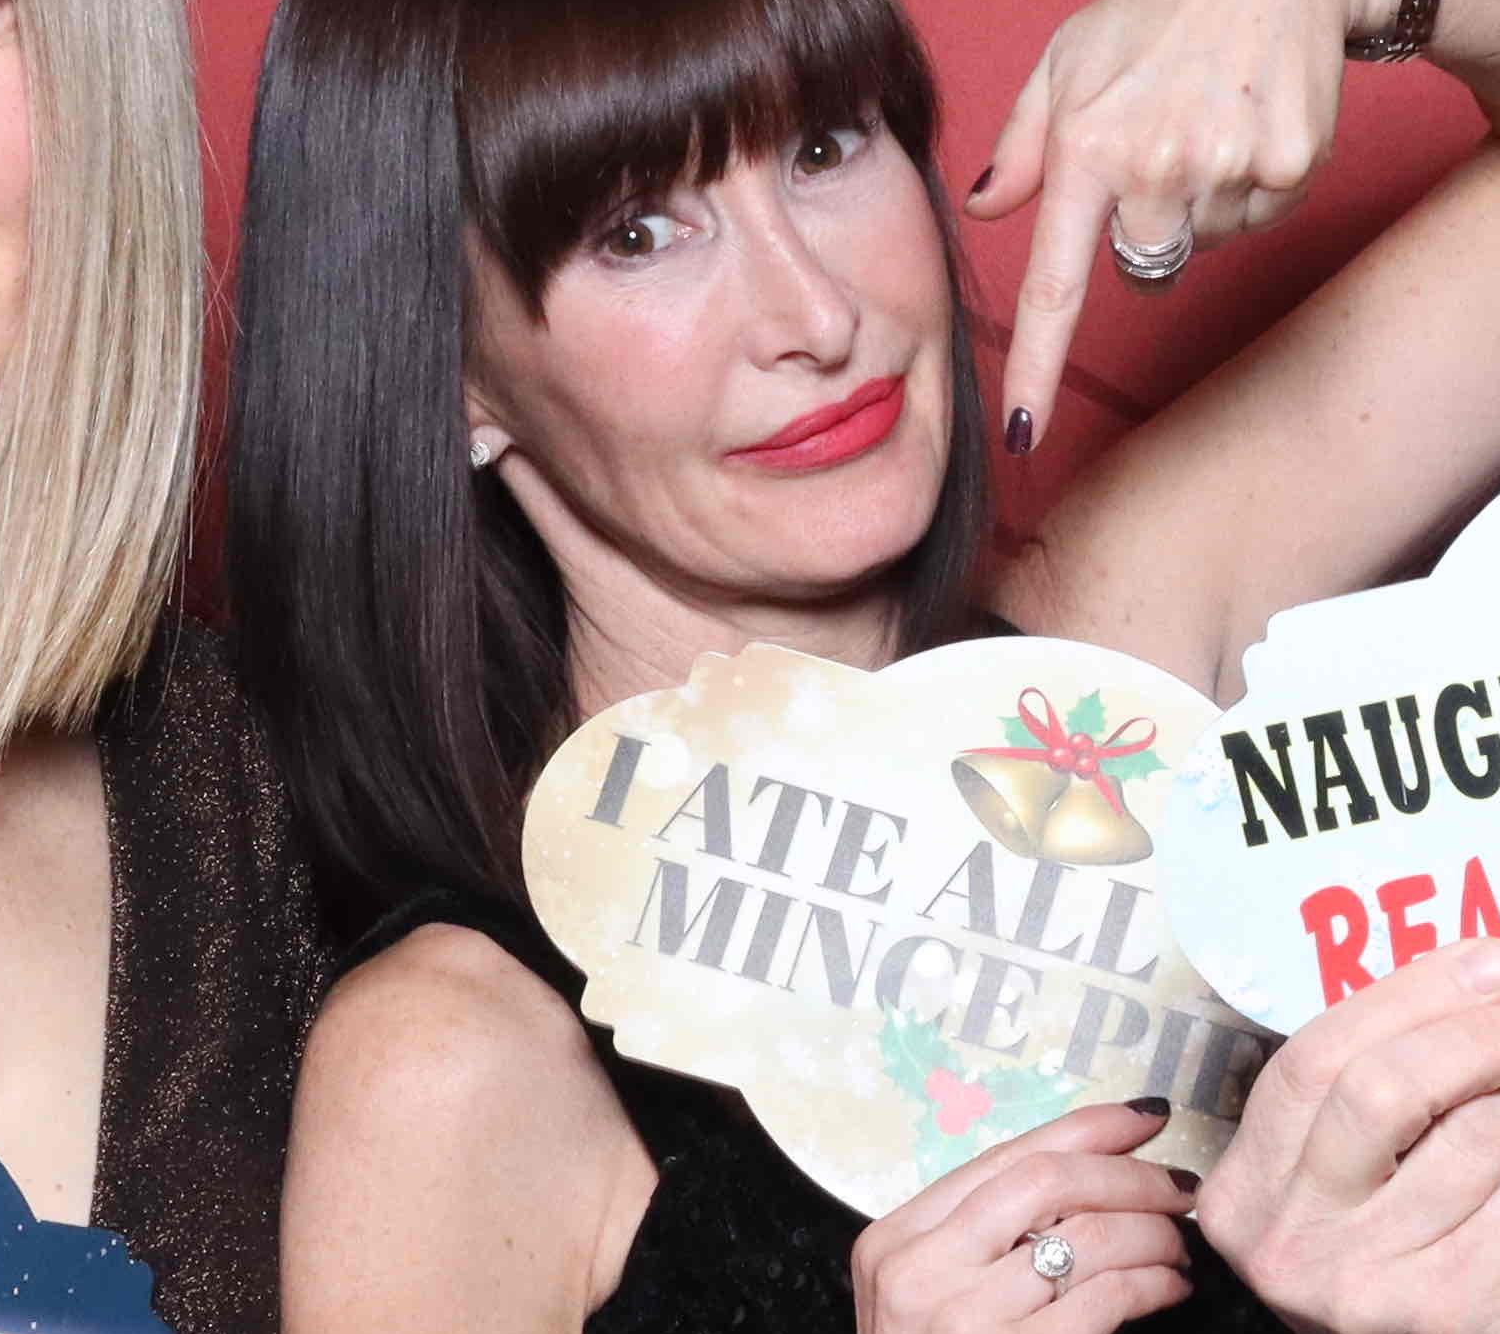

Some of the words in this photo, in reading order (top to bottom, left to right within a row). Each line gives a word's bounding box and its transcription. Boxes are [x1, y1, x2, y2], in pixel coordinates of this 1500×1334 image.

[585, 732, 652, 830] I
[652, 762, 908, 906] ATE
[915, 840, 1160, 985] ALL
[626, 857, 1045, 1060] MINCE
